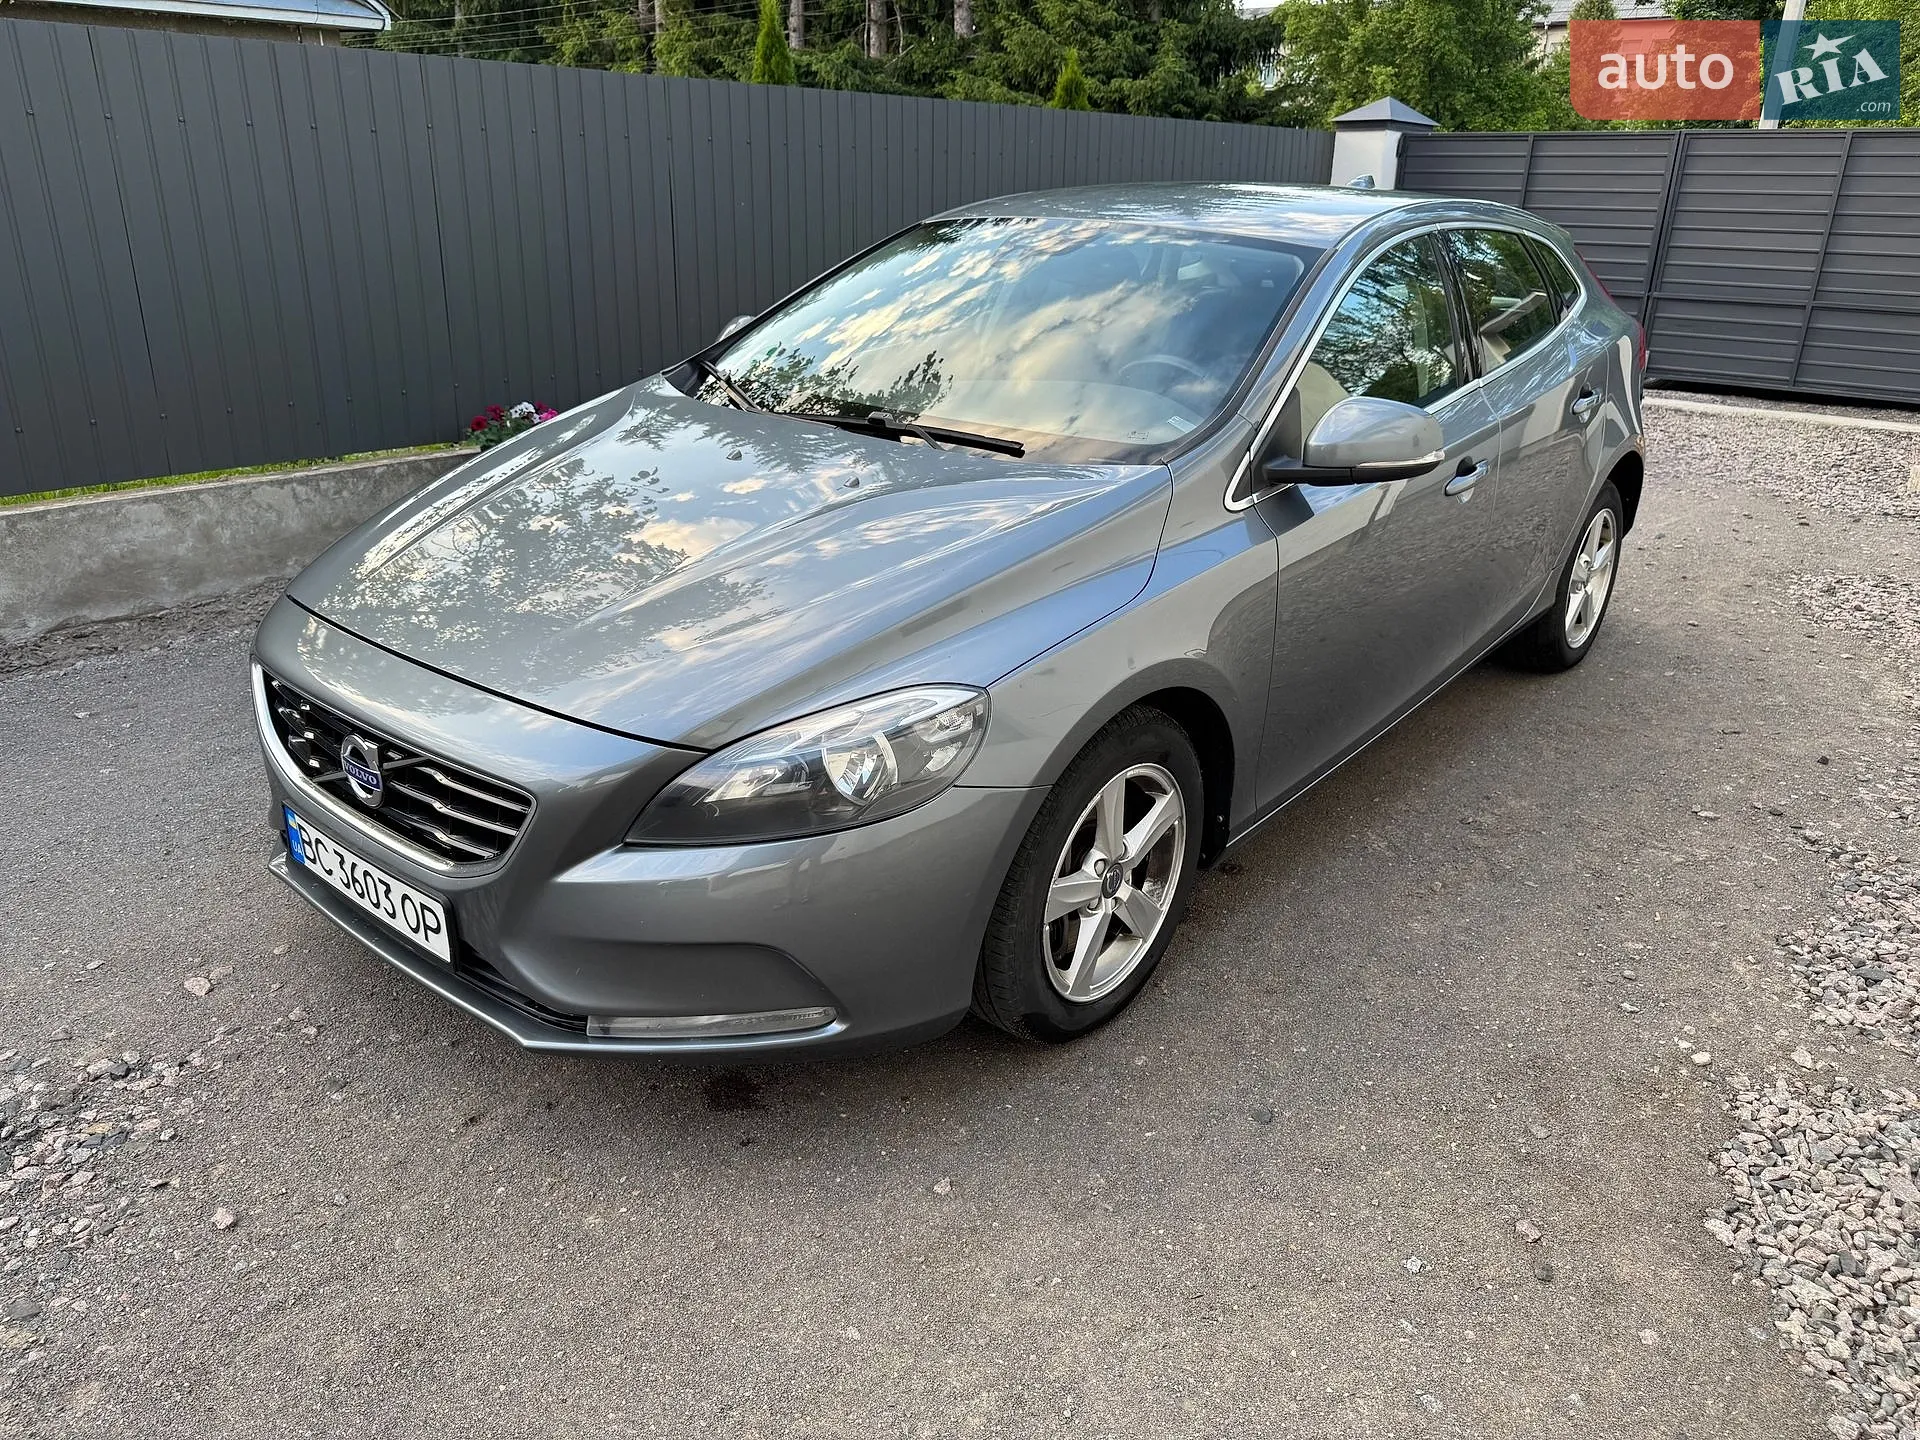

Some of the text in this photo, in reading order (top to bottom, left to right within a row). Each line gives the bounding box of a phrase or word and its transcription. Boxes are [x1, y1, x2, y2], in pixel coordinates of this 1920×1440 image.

[344, 762, 377, 785] VOLVO
[297, 822, 441, 943] BC 3603 OP
